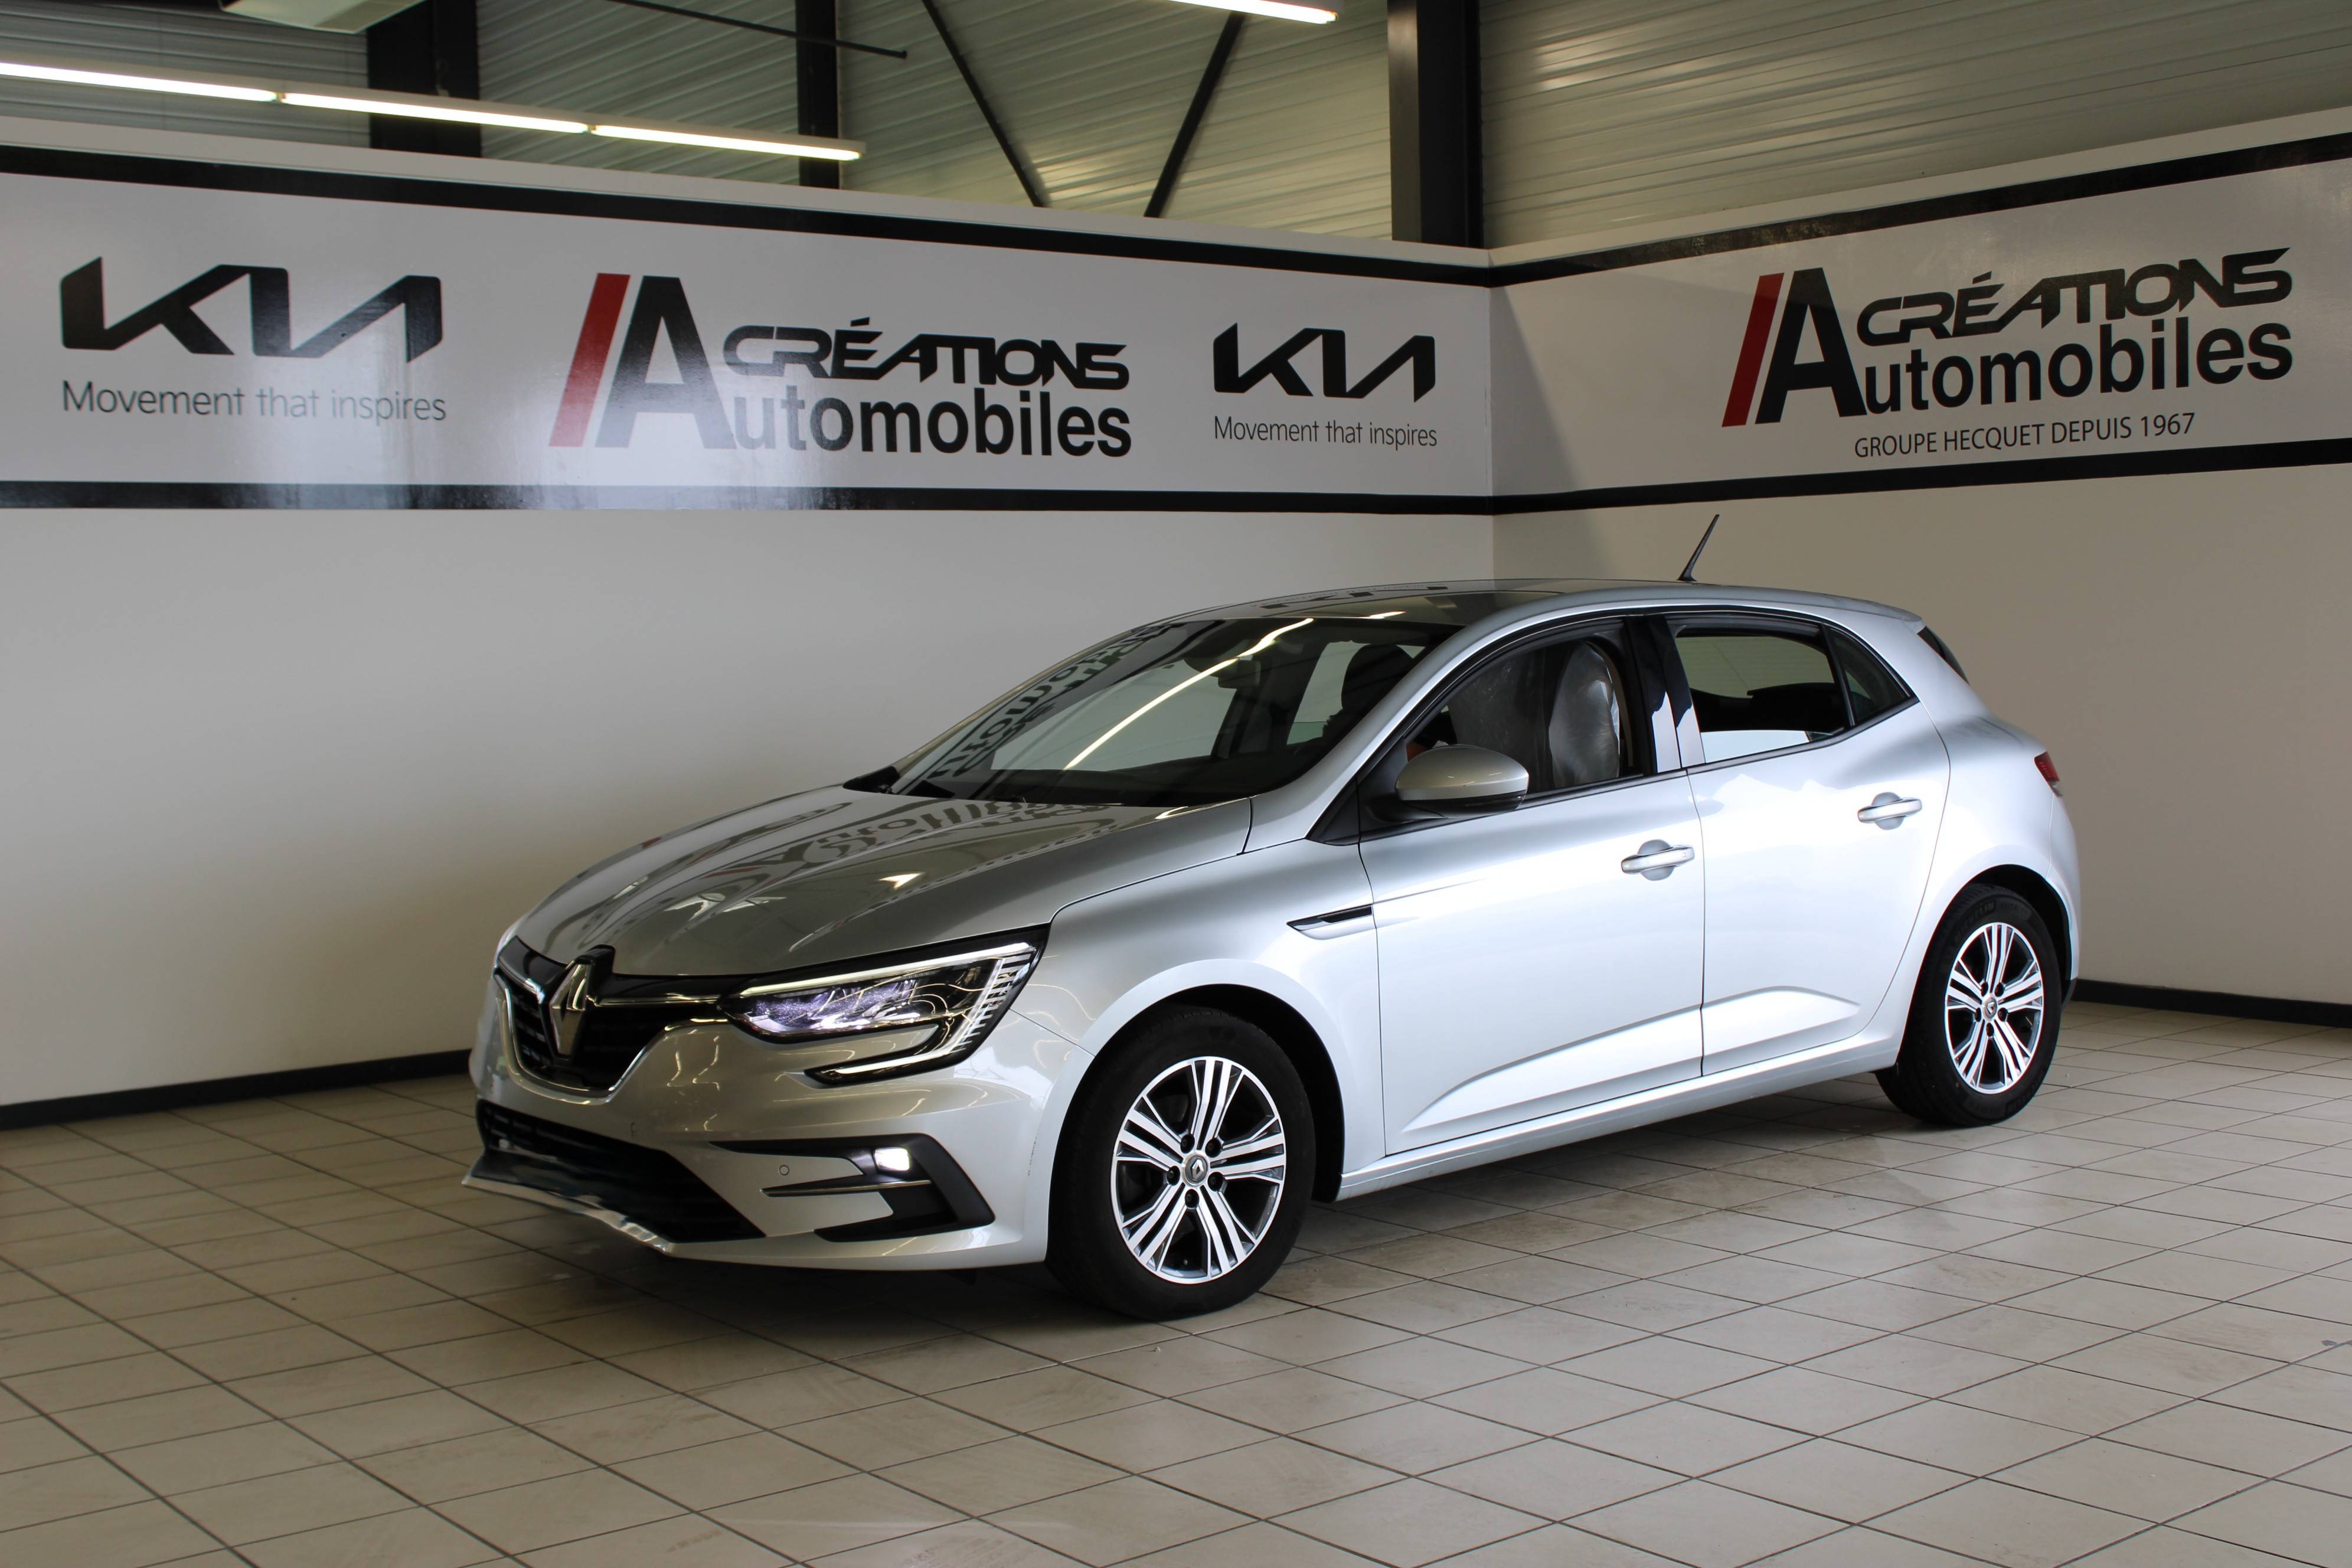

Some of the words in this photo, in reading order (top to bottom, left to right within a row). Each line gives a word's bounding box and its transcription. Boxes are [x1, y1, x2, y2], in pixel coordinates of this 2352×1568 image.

[60, 256, 443, 363] KIA
[1857, 247, 2293, 347] CRÉATIONS
[595, 275, 1132, 458] Automobiles
[722, 316, 1130, 390] CRÉATIONS
[1213, 322, 1436, 403] KIA
[1755, 267, 2293, 424] Automobiles
[62, 380, 244, 416] Movement
[256, 387, 319, 418] that
[331, 389, 447, 425] inspires
[1214, 415, 1319, 443] Movement
[1325, 419, 1363, 445] that
[1369, 422, 1438, 452] inspires
[1854, 432, 1938, 458] GROUPE
[1943, 423, 2046, 452] HECQUET
[2051, 416, 2132, 444] DEPUIS
[2140, 411, 2196, 437] 1967
